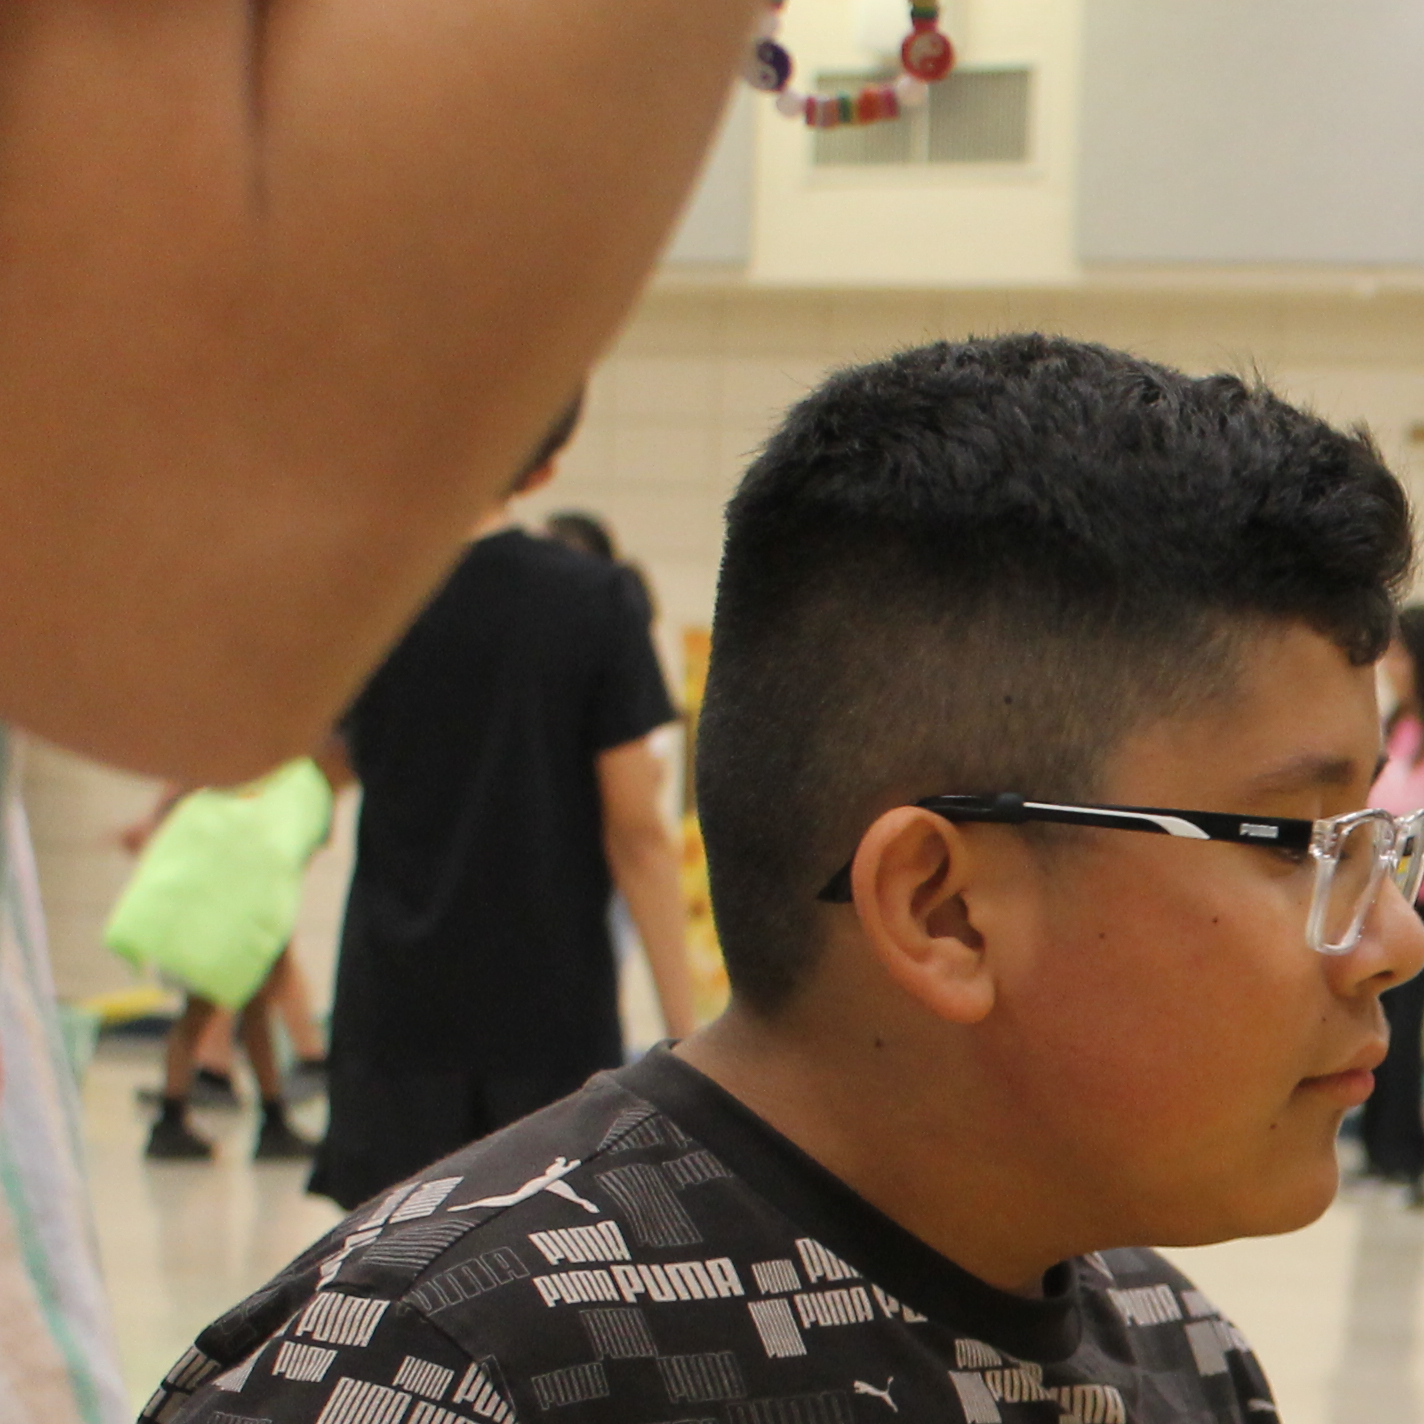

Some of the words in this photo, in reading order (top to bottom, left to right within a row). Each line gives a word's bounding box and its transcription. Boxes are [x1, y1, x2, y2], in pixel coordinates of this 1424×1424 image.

[527, 1220, 632, 1266] PUMA
[532, 1268, 621, 1308] PUMA
[610, 1256, 746, 1303] PUMA
[295, 1291, 391, 1348] PUMA
[793, 1285, 875, 1330] PUMA
